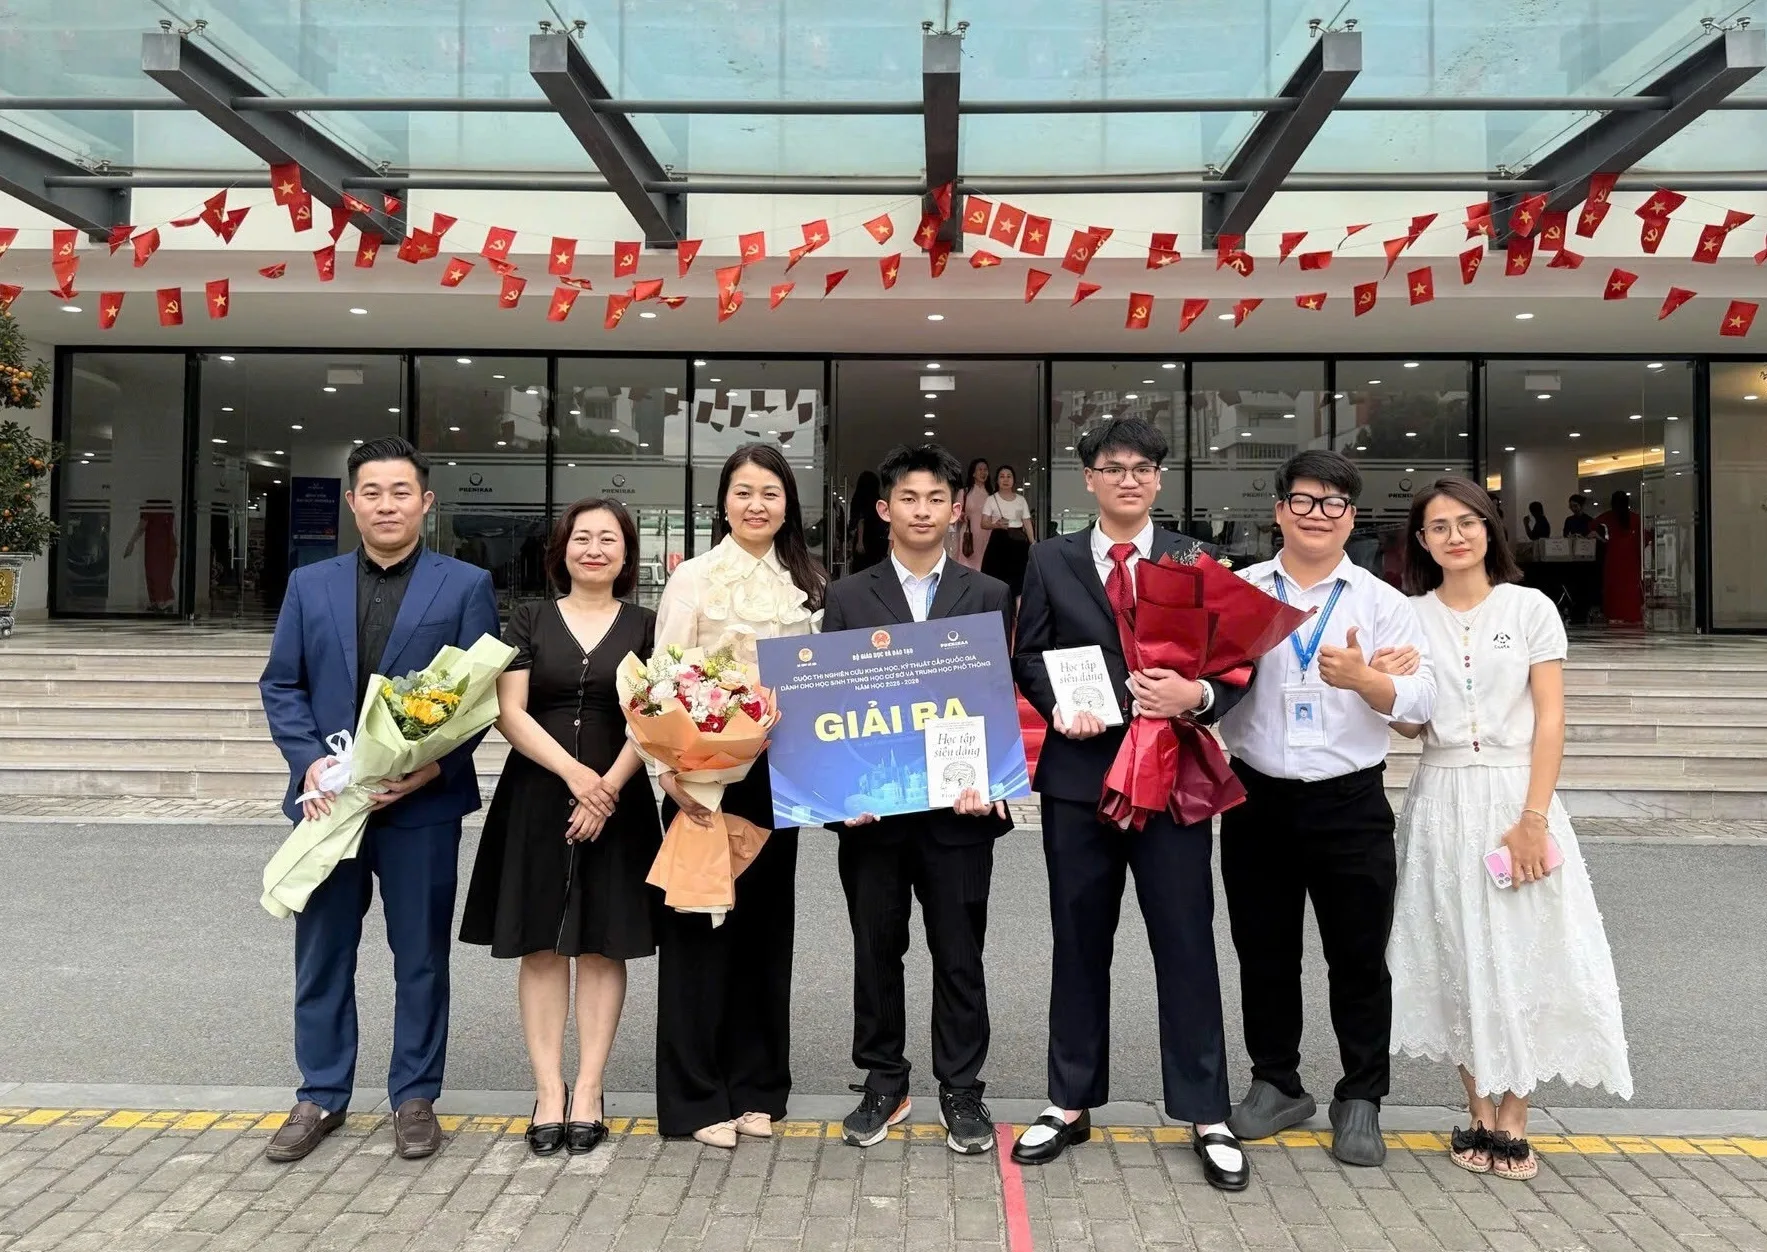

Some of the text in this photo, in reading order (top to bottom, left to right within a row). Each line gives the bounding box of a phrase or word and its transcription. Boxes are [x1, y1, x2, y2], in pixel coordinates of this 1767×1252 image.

[780, 681, 800, 691] DÀNH
[815, 680, 830, 689] HỌC
[830, 679, 846, 687] SINH
[846, 676, 869, 685] TRUNG
[869, 674, 884, 682] HỌC
[884, 672, 895, 680] CƠ
[915, 667, 938, 676] TRUNG
[938, 665, 953, 673] HỌC
[968, 660, 991, 669] THÔNG
[793, 674, 813, 683] CUỘC
[824, 670, 850, 680] NGHIÊN
[850, 668, 864, 676] CỨU
[864, 667, 884, 675] KHOA
[945, 655, 964, 664] QUỐC
[1060, 661, 1078, 673] Học
[814, 697, 968, 742] GIẢI BA
[938, 733, 957, 746] Học
